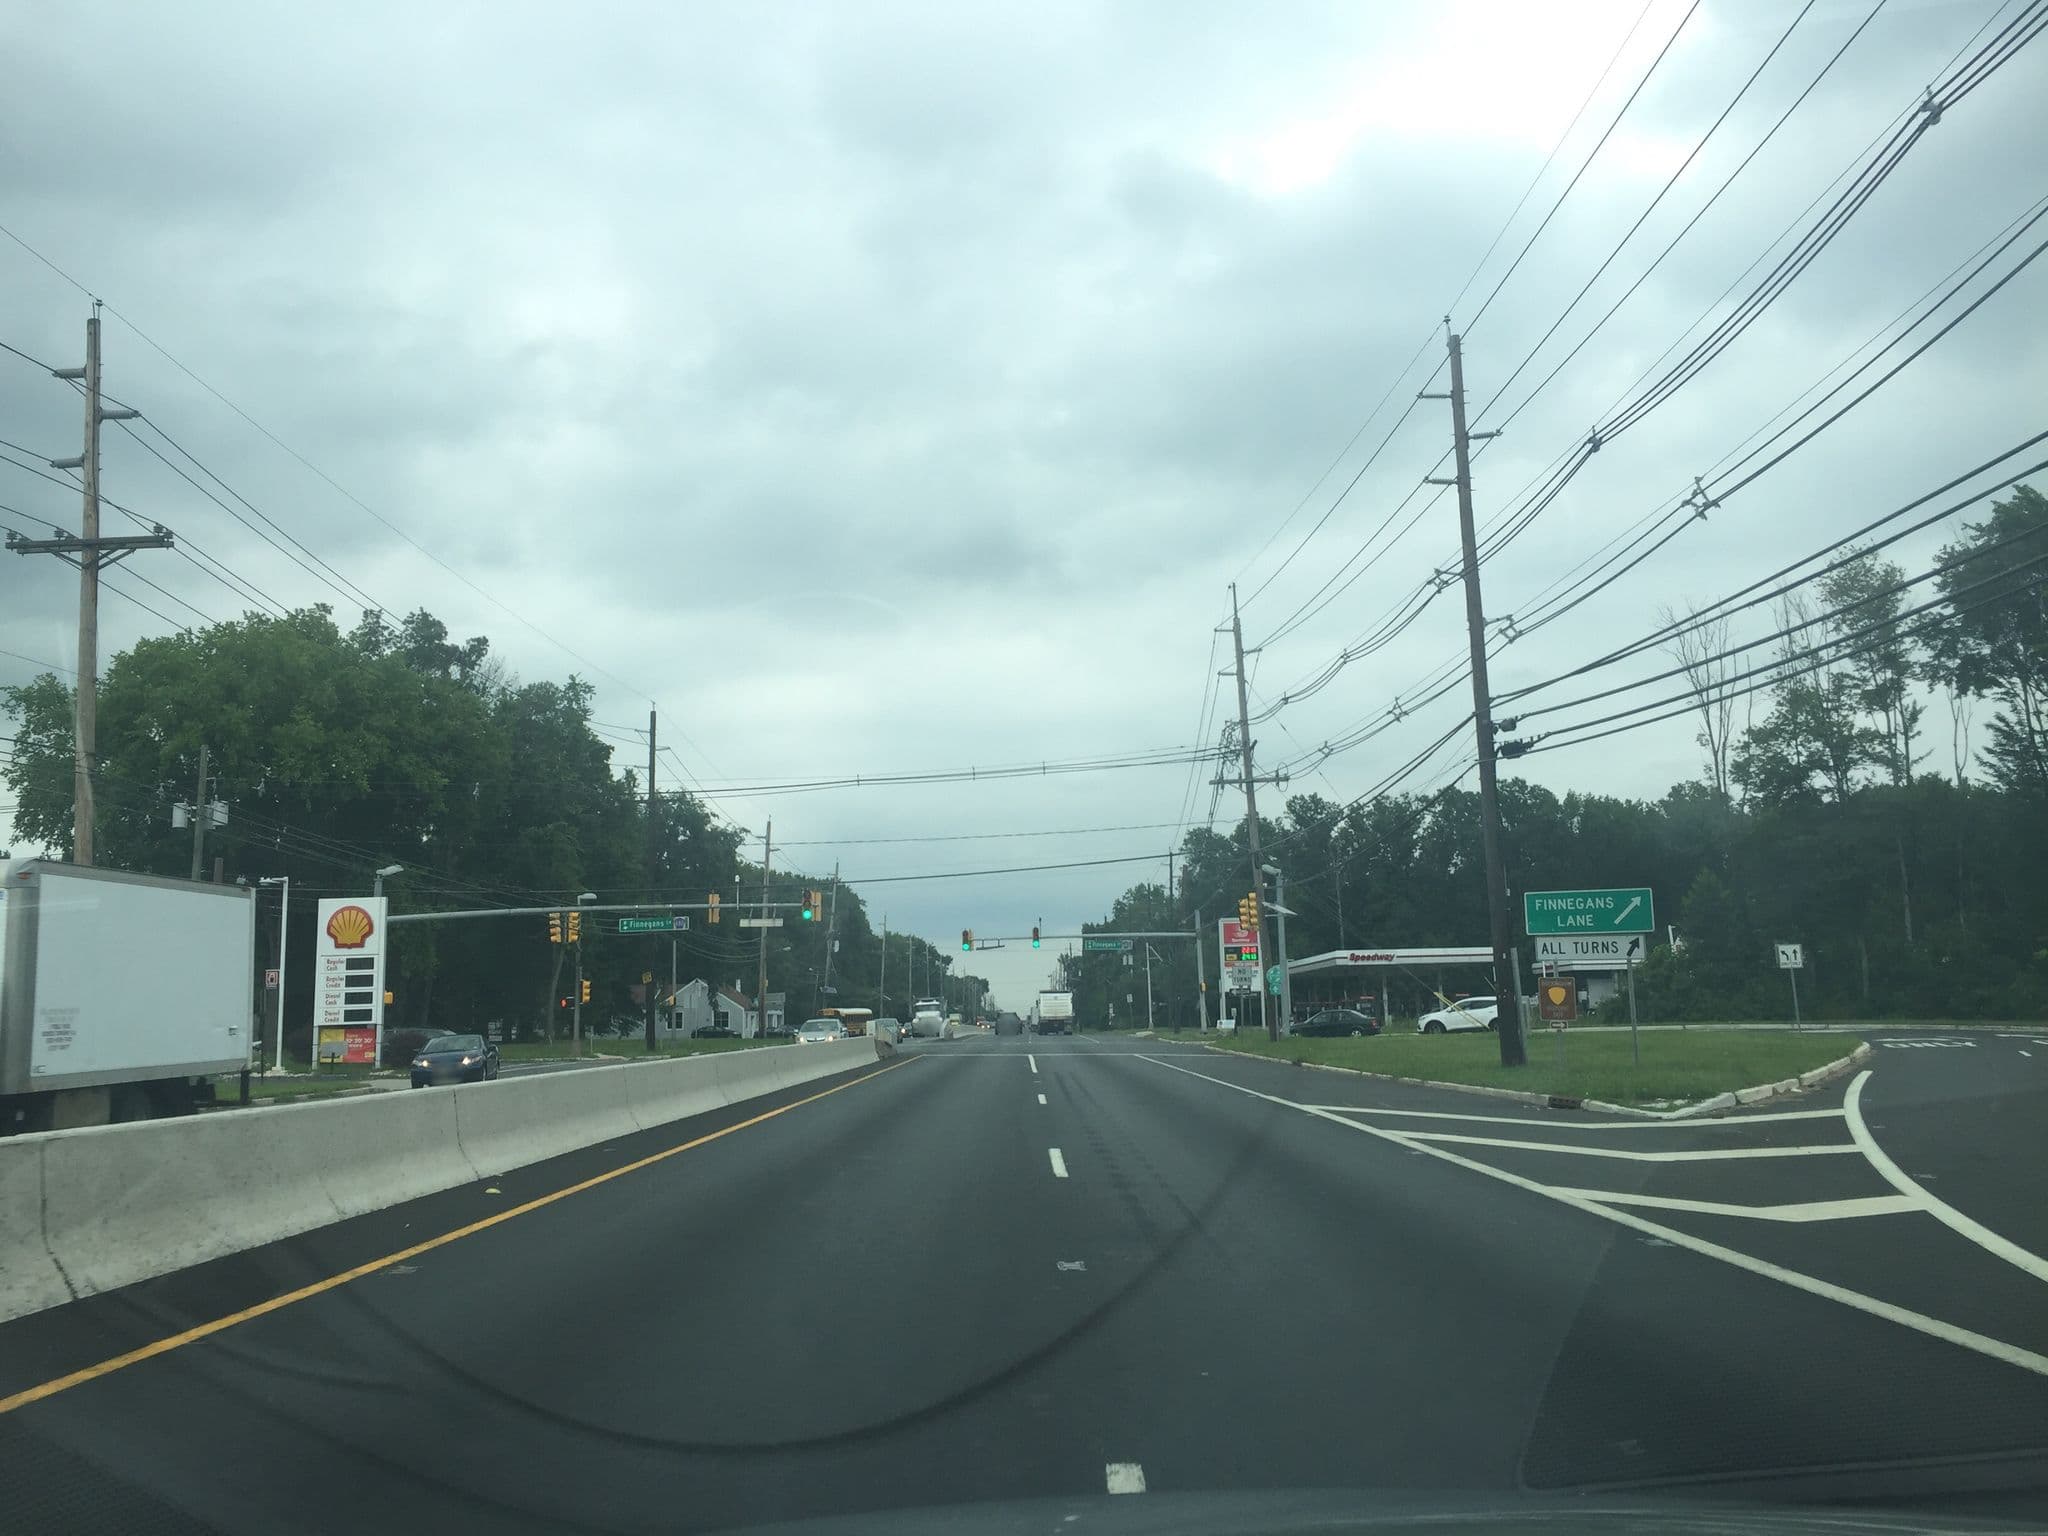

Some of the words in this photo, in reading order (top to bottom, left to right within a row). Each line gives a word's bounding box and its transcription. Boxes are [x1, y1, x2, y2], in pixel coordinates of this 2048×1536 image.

[1535, 897, 1614, 911] FINNEGANS
[1557, 914, 1594, 927] LANE
[1541, 942, 1566, 954] ALL
[1573, 941, 1619, 954] TURNS
[1349, 953, 1395, 963] Speedway
